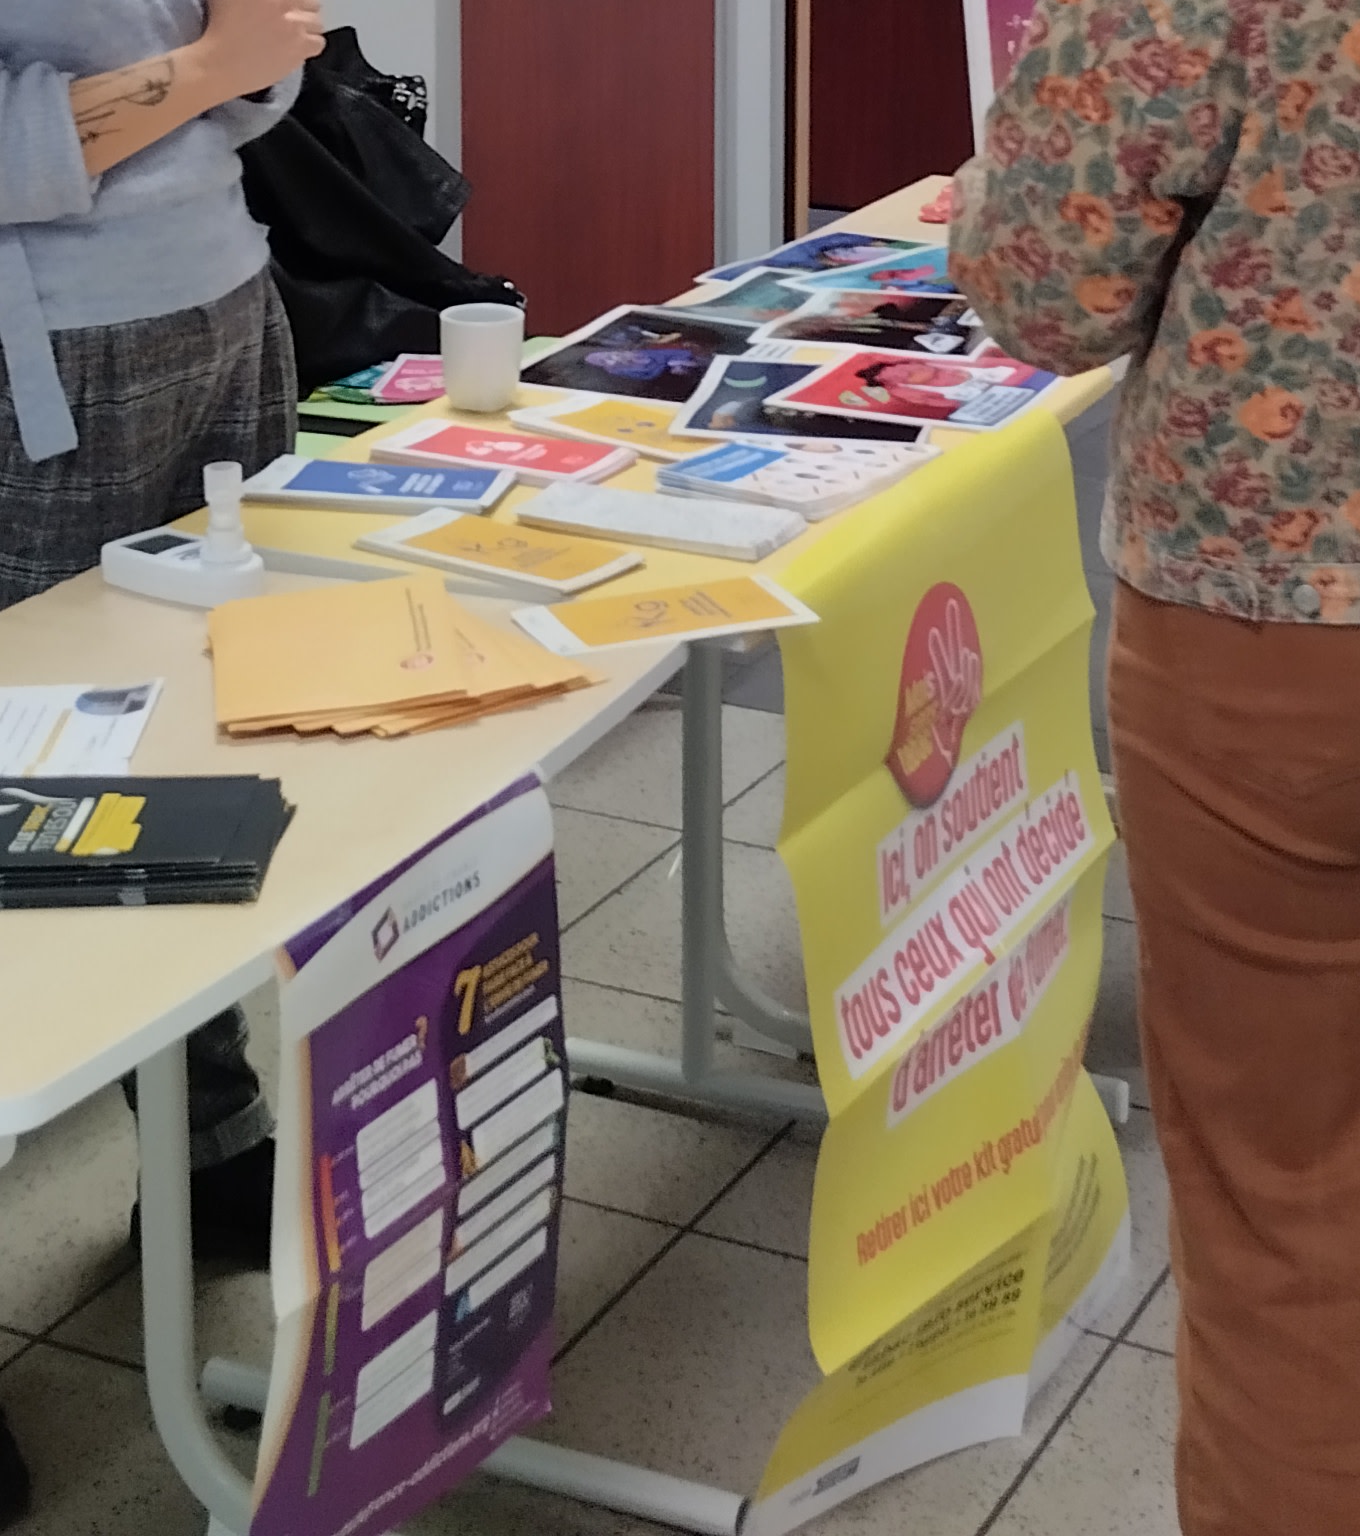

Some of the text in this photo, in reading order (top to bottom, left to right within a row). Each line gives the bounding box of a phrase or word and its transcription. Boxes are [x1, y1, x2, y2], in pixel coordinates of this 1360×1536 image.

[913, 814, 939, 880] on
[941, 731, 1024, 853] soutient
[841, 967, 903, 1061] tous
[892, 910, 965, 1007] ceux
[948, 865, 1002, 965] qui
[981, 840, 1031, 917] ont
[909, 1182, 932, 1228] ici
[931, 1160, 974, 1213] votre
[973, 1139, 999, 1182] kit
